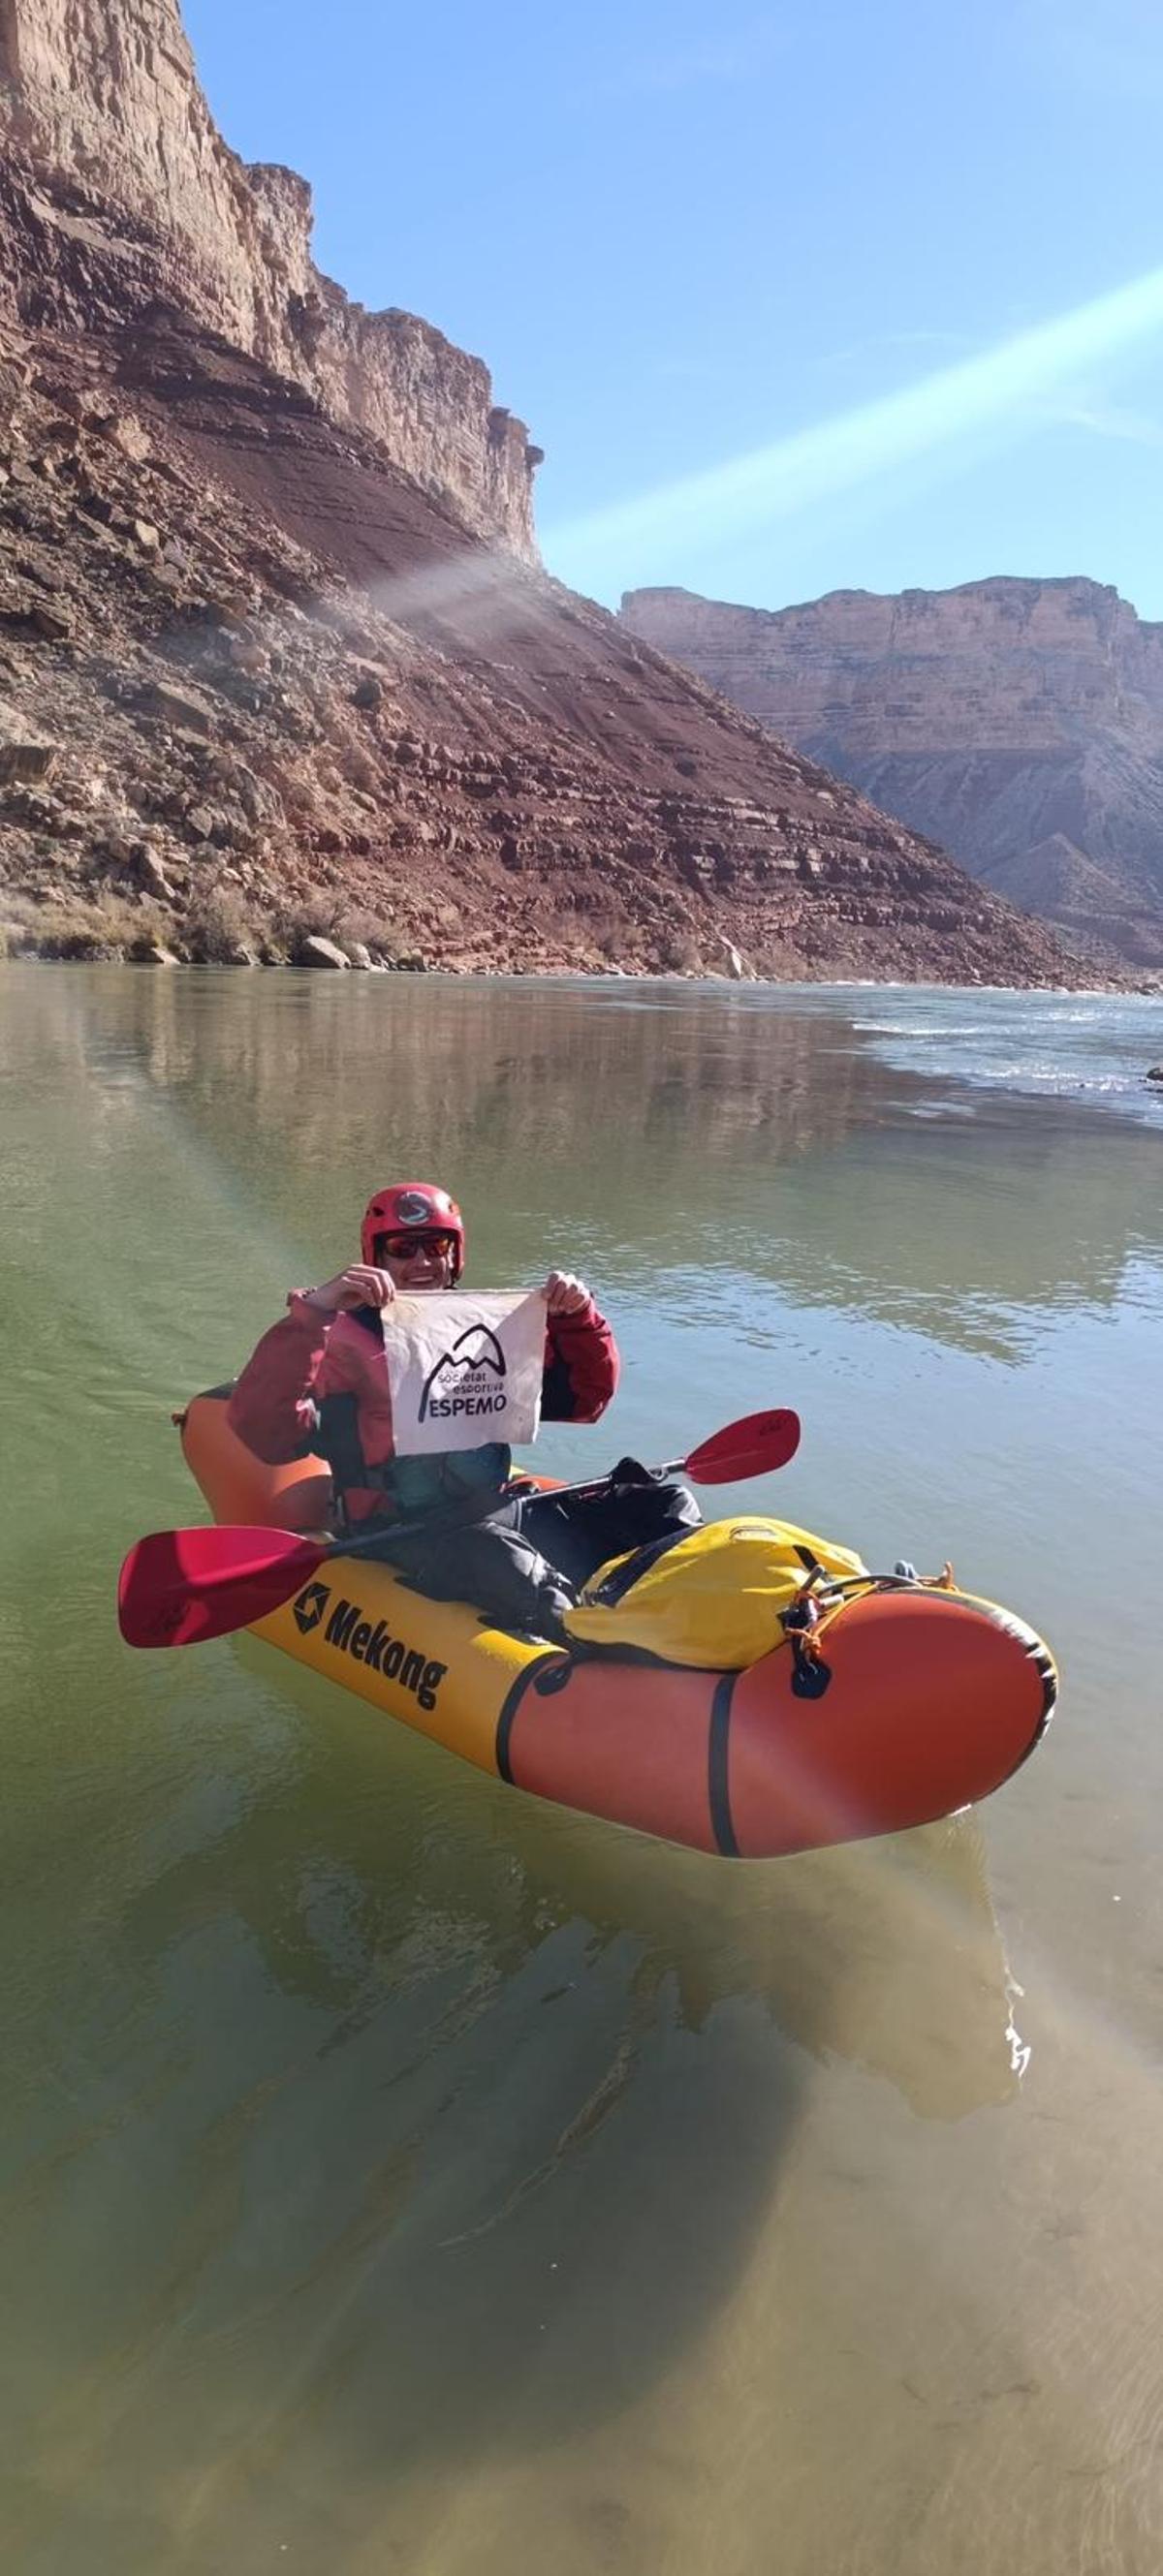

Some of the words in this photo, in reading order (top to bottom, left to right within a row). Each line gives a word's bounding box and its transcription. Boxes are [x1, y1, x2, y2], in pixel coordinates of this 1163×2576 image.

[454, 1382, 504, 1394] esportiva
[429, 1395, 507, 1417] ESPEMO
[325, 1599, 448, 1711] Mekong
